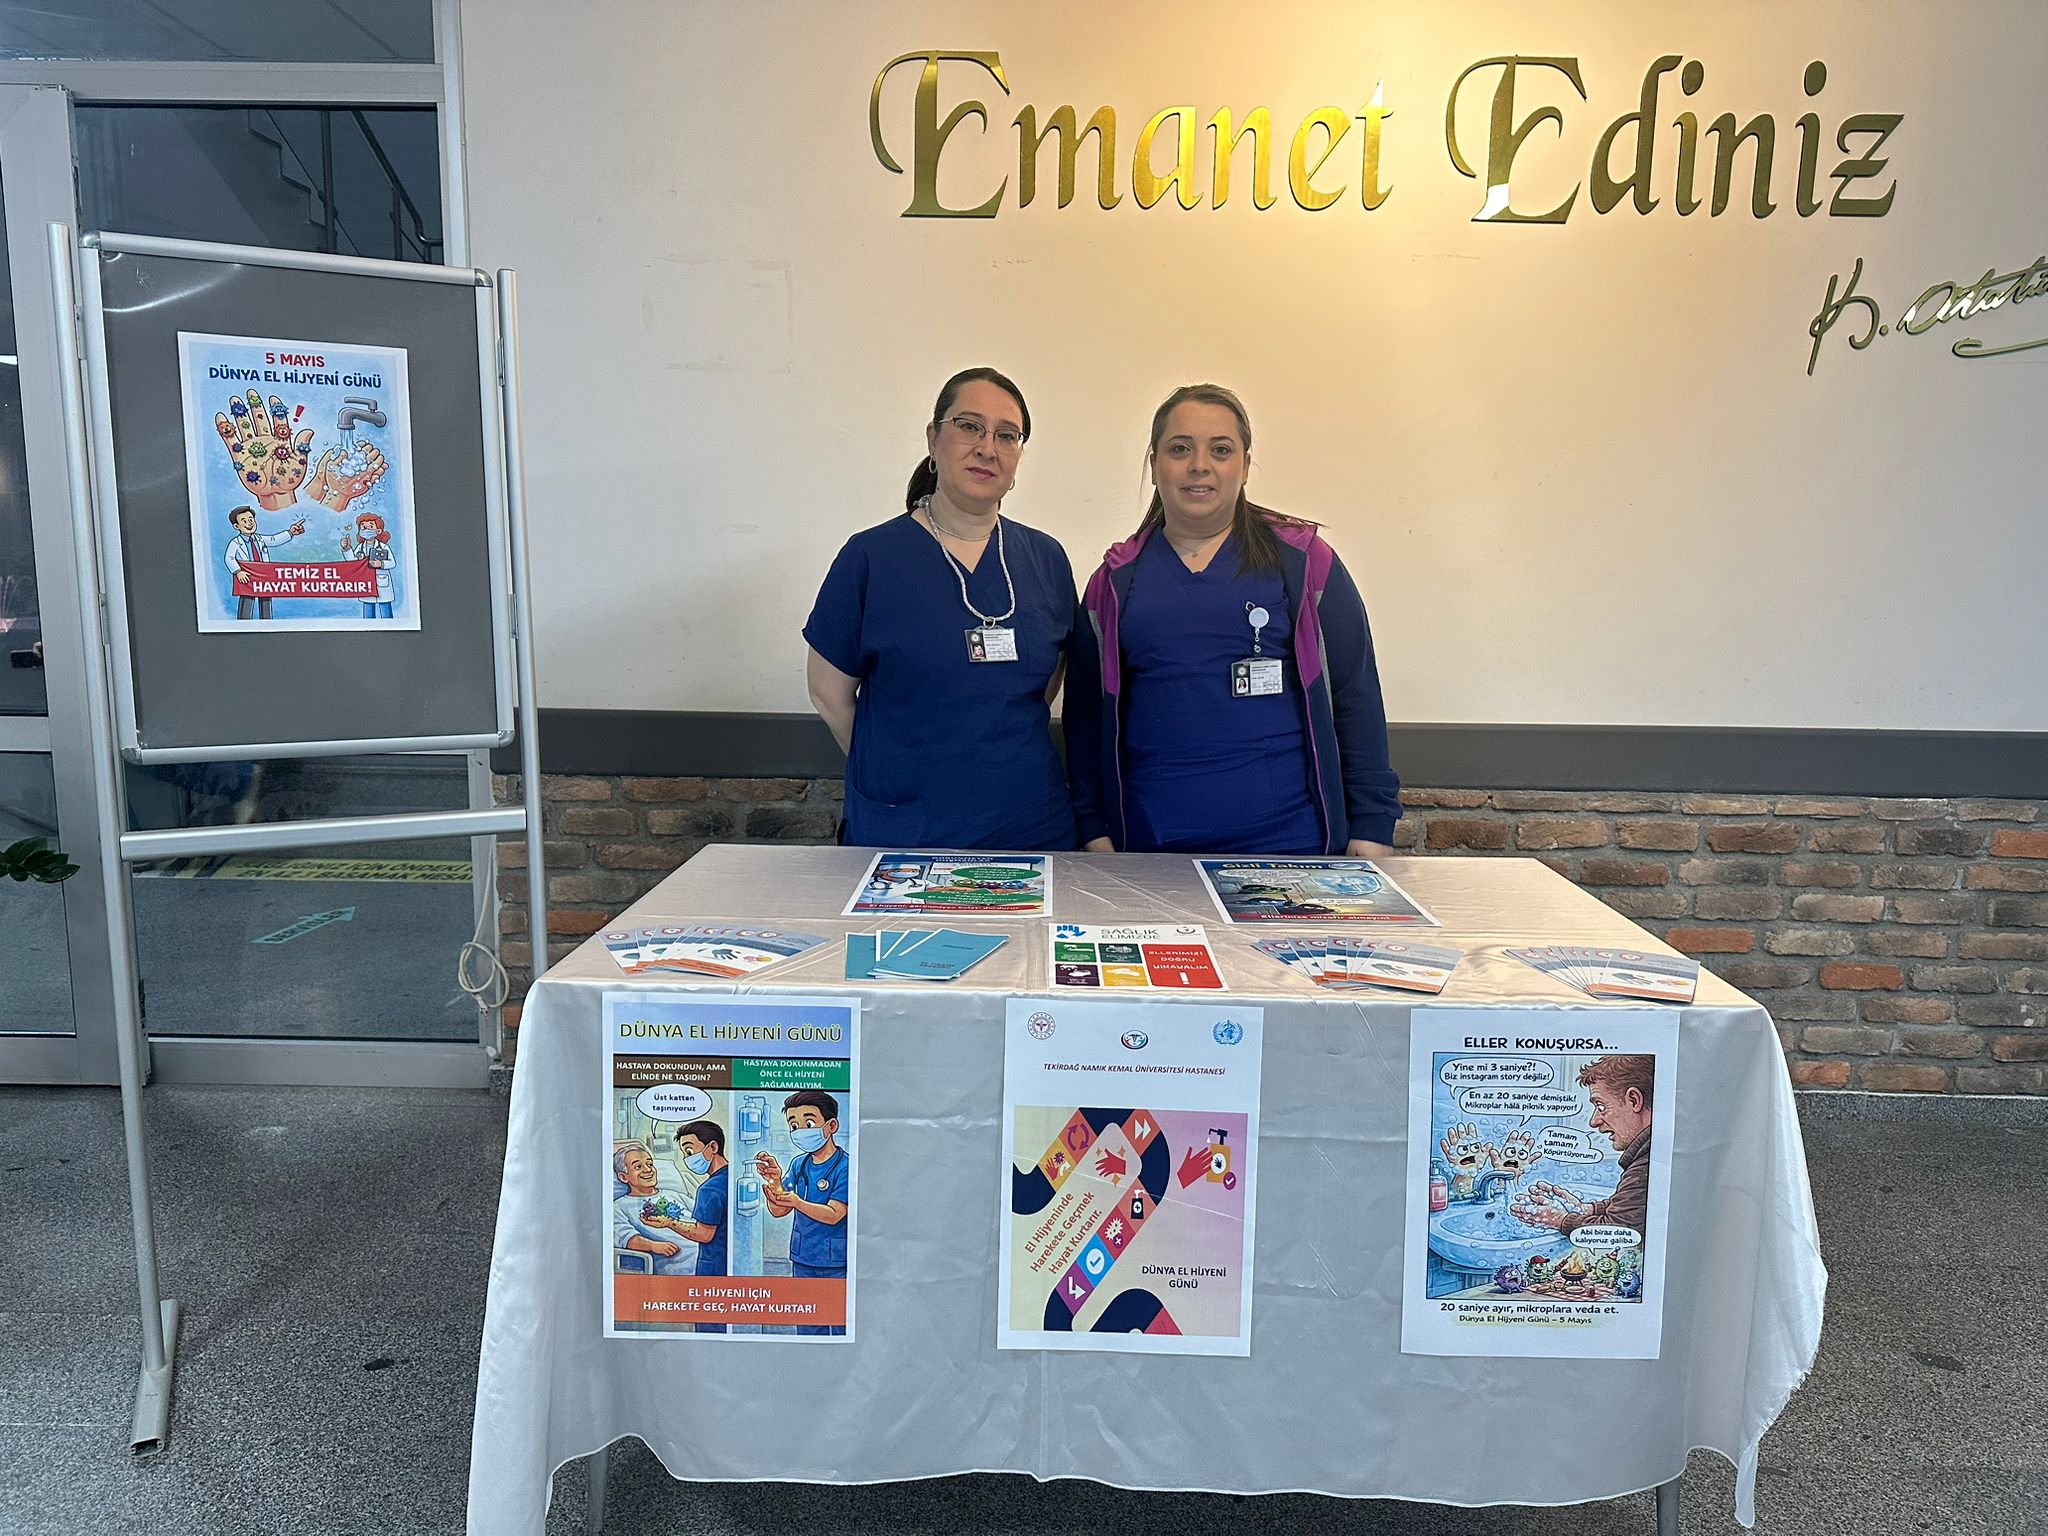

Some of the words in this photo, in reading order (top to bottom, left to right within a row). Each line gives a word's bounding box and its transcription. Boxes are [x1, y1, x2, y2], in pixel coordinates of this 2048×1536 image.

[869, 49, 1396, 219] Emanet
[1446, 54, 1905, 225] Ediniz
[265, 352, 276, 365] 5
[279, 353, 326, 368] MAYIS
[208, 364, 261, 382] DÜNYA
[263, 369, 281, 383] EL
[284, 369, 340, 386] HİJYENİ
[342, 372, 382, 389] GÜNÜ
[274, 564, 320, 580] TEMİZ
[323, 567, 341, 580] EL
[252, 580, 297, 593] HAYAT
[301, 581, 372, 593] KURTARIR!
[1100, 926, 1159, 935] SAĞLIK
[619, 1020, 684, 1038] DÜNYA
[689, 1024, 708, 1039] EL
[714, 1022, 782, 1041] HİJYENİ
[787, 1023, 843, 1042] GÜNÜ
[1463, 1036, 1508, 1050] ELLER
[1515, 1037, 1619, 1053] KONUŞURSA...
[616, 1062, 652, 1071] HASTAYA
[653, 1063, 705, 1072] DOKUNDUN,
[705, 1064, 727, 1072] AMA
[743, 1059, 779, 1068] HASTAYA
[780, 1060, 843, 1069] DOKUNMADAN
[1043, 1062, 1081, 1072] TEKİRDAĞ
[1080, 1064, 1108, 1073] NAMIK
[1107, 1065, 1134, 1074] KEMAL
[1134, 1064, 1185, 1075] ÜNİVERSİTESİ
[1184, 1066, 1227, 1076] HASTANESİ
[1452, 1062, 1475, 1072] Yine
[1476, 1062, 1489, 1072] mi
[1490, 1063, 1498, 1072] 3
[1499, 1062, 1537, 1074] saniye?!
[631, 1071, 660, 1080] ELİNDE
[661, 1073, 674, 1081] NE
[674, 1073, 712, 1083] TAŞIDIN?
[760, 1069, 783, 1078] ÖNCE
[784, 1070, 794, 1078] EL
[1444, 1072, 1458, 1080] Biz
[1500, 1073, 1522, 1082] story
[1522, 1072, 1551, 1083] değiliz!
[760, 1080, 825, 1090] SAĞLAMALIYIM.
[653, 1093, 668, 1101] Üst
[669, 1093, 696, 1102] kattan
[1469, 1091, 1481, 1100] En
[1496, 1091, 1510, 1100] 20
[1511, 1092, 1539, 1103] saniye
[1540, 1092, 1577, 1104] demiştik!
[652, 1104, 697, 1113] taşınıyoruz
[1465, 1101, 1502, 1111] Mikroplar
[1521, 1101, 1546, 1112] piknik
[1546, 1102, 1578, 1113] yapıyor!
[1547, 1130, 1578, 1141] Tamam
[1543, 1139, 1579, 1150] tamam!
[1543, 1147, 1598, 1160] Köpürtüyorum!
[1024, 1241, 1037, 1254] El
[1032, 1193, 1075, 1243] Hijyeninde
[1030, 1230, 1066, 1272] Harekete
[1062, 1192, 1095, 1230] Geçmek
[1580, 1228, 1593, 1236] Abi
[1594, 1228, 1613, 1236] biraz
[1048, 1246, 1074, 1275] Hayat
[1069, 1209, 1103, 1247] Kurtarır.
[1141, 1264, 1176, 1276] DÜNYA
[1178, 1267, 1189, 1276] EL
[1190, 1265, 1227, 1277] HİJYENİ
[1168, 1278, 1199, 1289] GÜNÜ
[688, 1287, 701, 1298] EL
[703, 1286, 746, 1299] HİJYENİ
[748, 1287, 771, 1300] İÇİN
[643, 1301, 701, 1312] HAREKETE
[703, 1302, 729, 1315] GEÇ,
[731, 1303, 766, 1313] HAYAT
[768, 1303, 817, 1314] KURTAR!
[1440, 1302, 1456, 1312] 20
[1458, 1302, 1490, 1314] saniye
[1491, 1304, 1515, 1315] ayır,
[1516, 1303, 1572, 1315] mikroplara
[1575, 1305, 1601, 1314] veda
[1603, 1306, 1620, 1315] et.
[1459, 1314, 1485, 1323] Dünya
[1487, 1315, 1496, 1323] El
[1497, 1315, 1525, 1324] Hijyeni
[1527, 1315, 1550, 1324] Günü
[1559, 1316, 1566, 1324] 5
[1567, 1316, 1592, 1325] Mayıs
